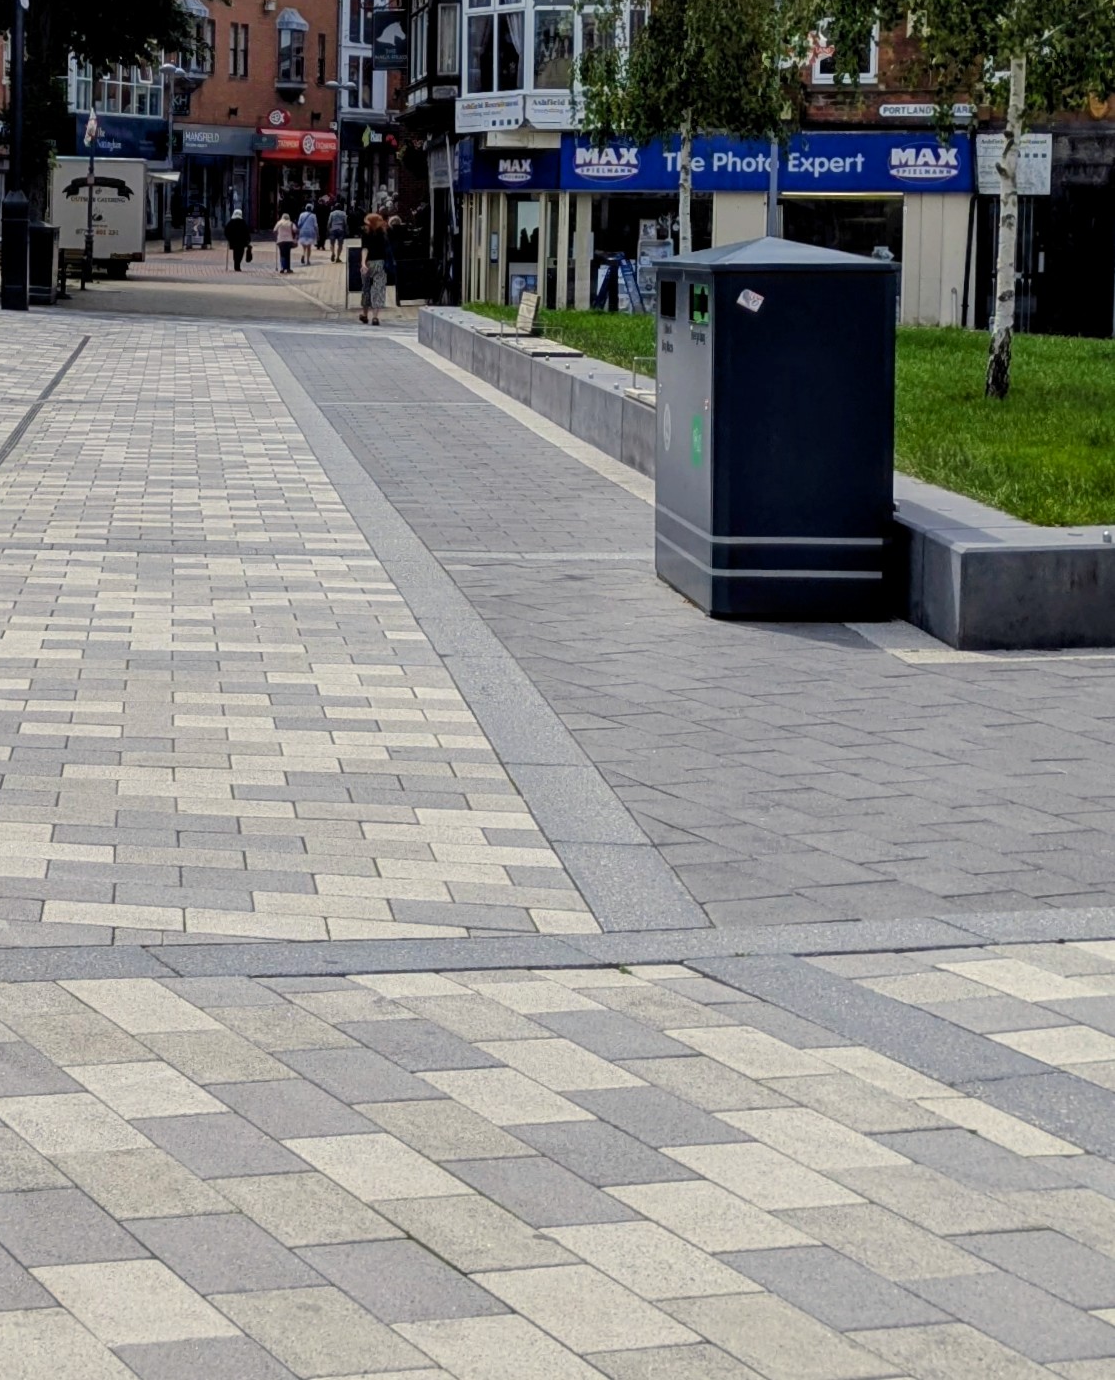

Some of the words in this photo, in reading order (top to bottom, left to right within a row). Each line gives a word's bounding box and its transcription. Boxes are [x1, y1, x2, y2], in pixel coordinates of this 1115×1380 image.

[461, 102, 483, 110] Ashfield
[485, 99, 518, 108] Recruitment
[883, 106, 933, 115] PORTLAND
[186, 131, 220, 142] MANSFIELD
[575, 147, 638, 165] MAX
[890, 148, 958, 166] MAX
[498, 158, 532, 172] MAX
[580, 166, 633, 174] SPIELMANN
[713, 151, 779, 173] Photo
[788, 152, 865, 178] Expert
